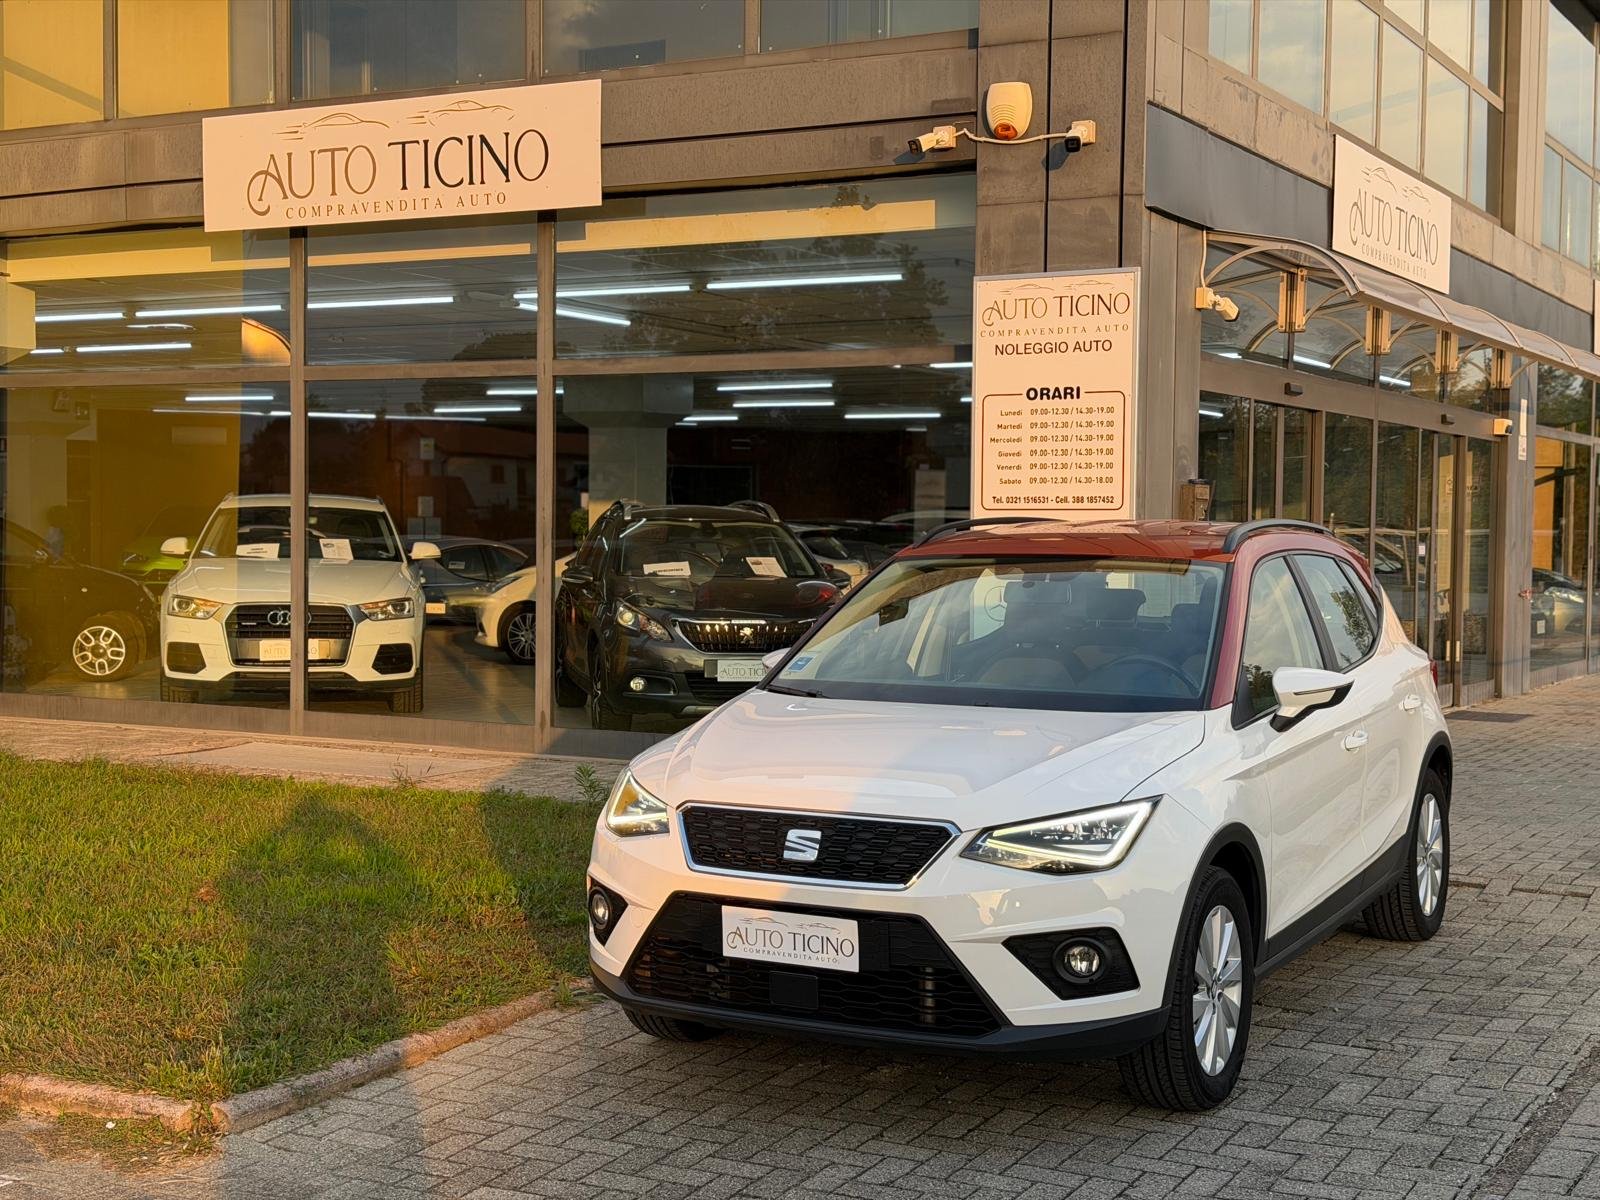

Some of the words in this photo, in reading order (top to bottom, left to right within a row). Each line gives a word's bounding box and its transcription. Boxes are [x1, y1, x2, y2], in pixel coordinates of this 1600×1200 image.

[247, 144, 377, 217] AUTO
[388, 128, 550, 191] TICINO
[285, 196, 443, 220] COMPRAVENDITA
[456, 191, 507, 208] AUTO
[1349, 188, 1393, 247] AUTO
[1395, 206, 1439, 266] TICINO
[982, 296, 1048, 327] AUTO
[1053, 292, 1130, 318] TICINO
[980, 326, 1087, 338] COMPRAVENDITA
[1095, 323, 1129, 333] AUTO
[994, 341, 1069, 356] NOLEGGIO
[1072, 339, 1113, 353] AUTO
[1026, 386, 1081, 401] ORARI
[1005, 496, 1021, 504] 0321
[1023, 496, 1049, 504] 1516531
[1072, 496, 1085, 504] 388
[1086, 496, 1115, 504] 1857452
[720, 667, 746, 679] AUTO
[726, 926, 784, 949] AUTO
[788, 931, 855, 958] TICINO
[743, 947, 813, 961] COMPRAVENDITA
[815, 955, 838, 964] AUTO
